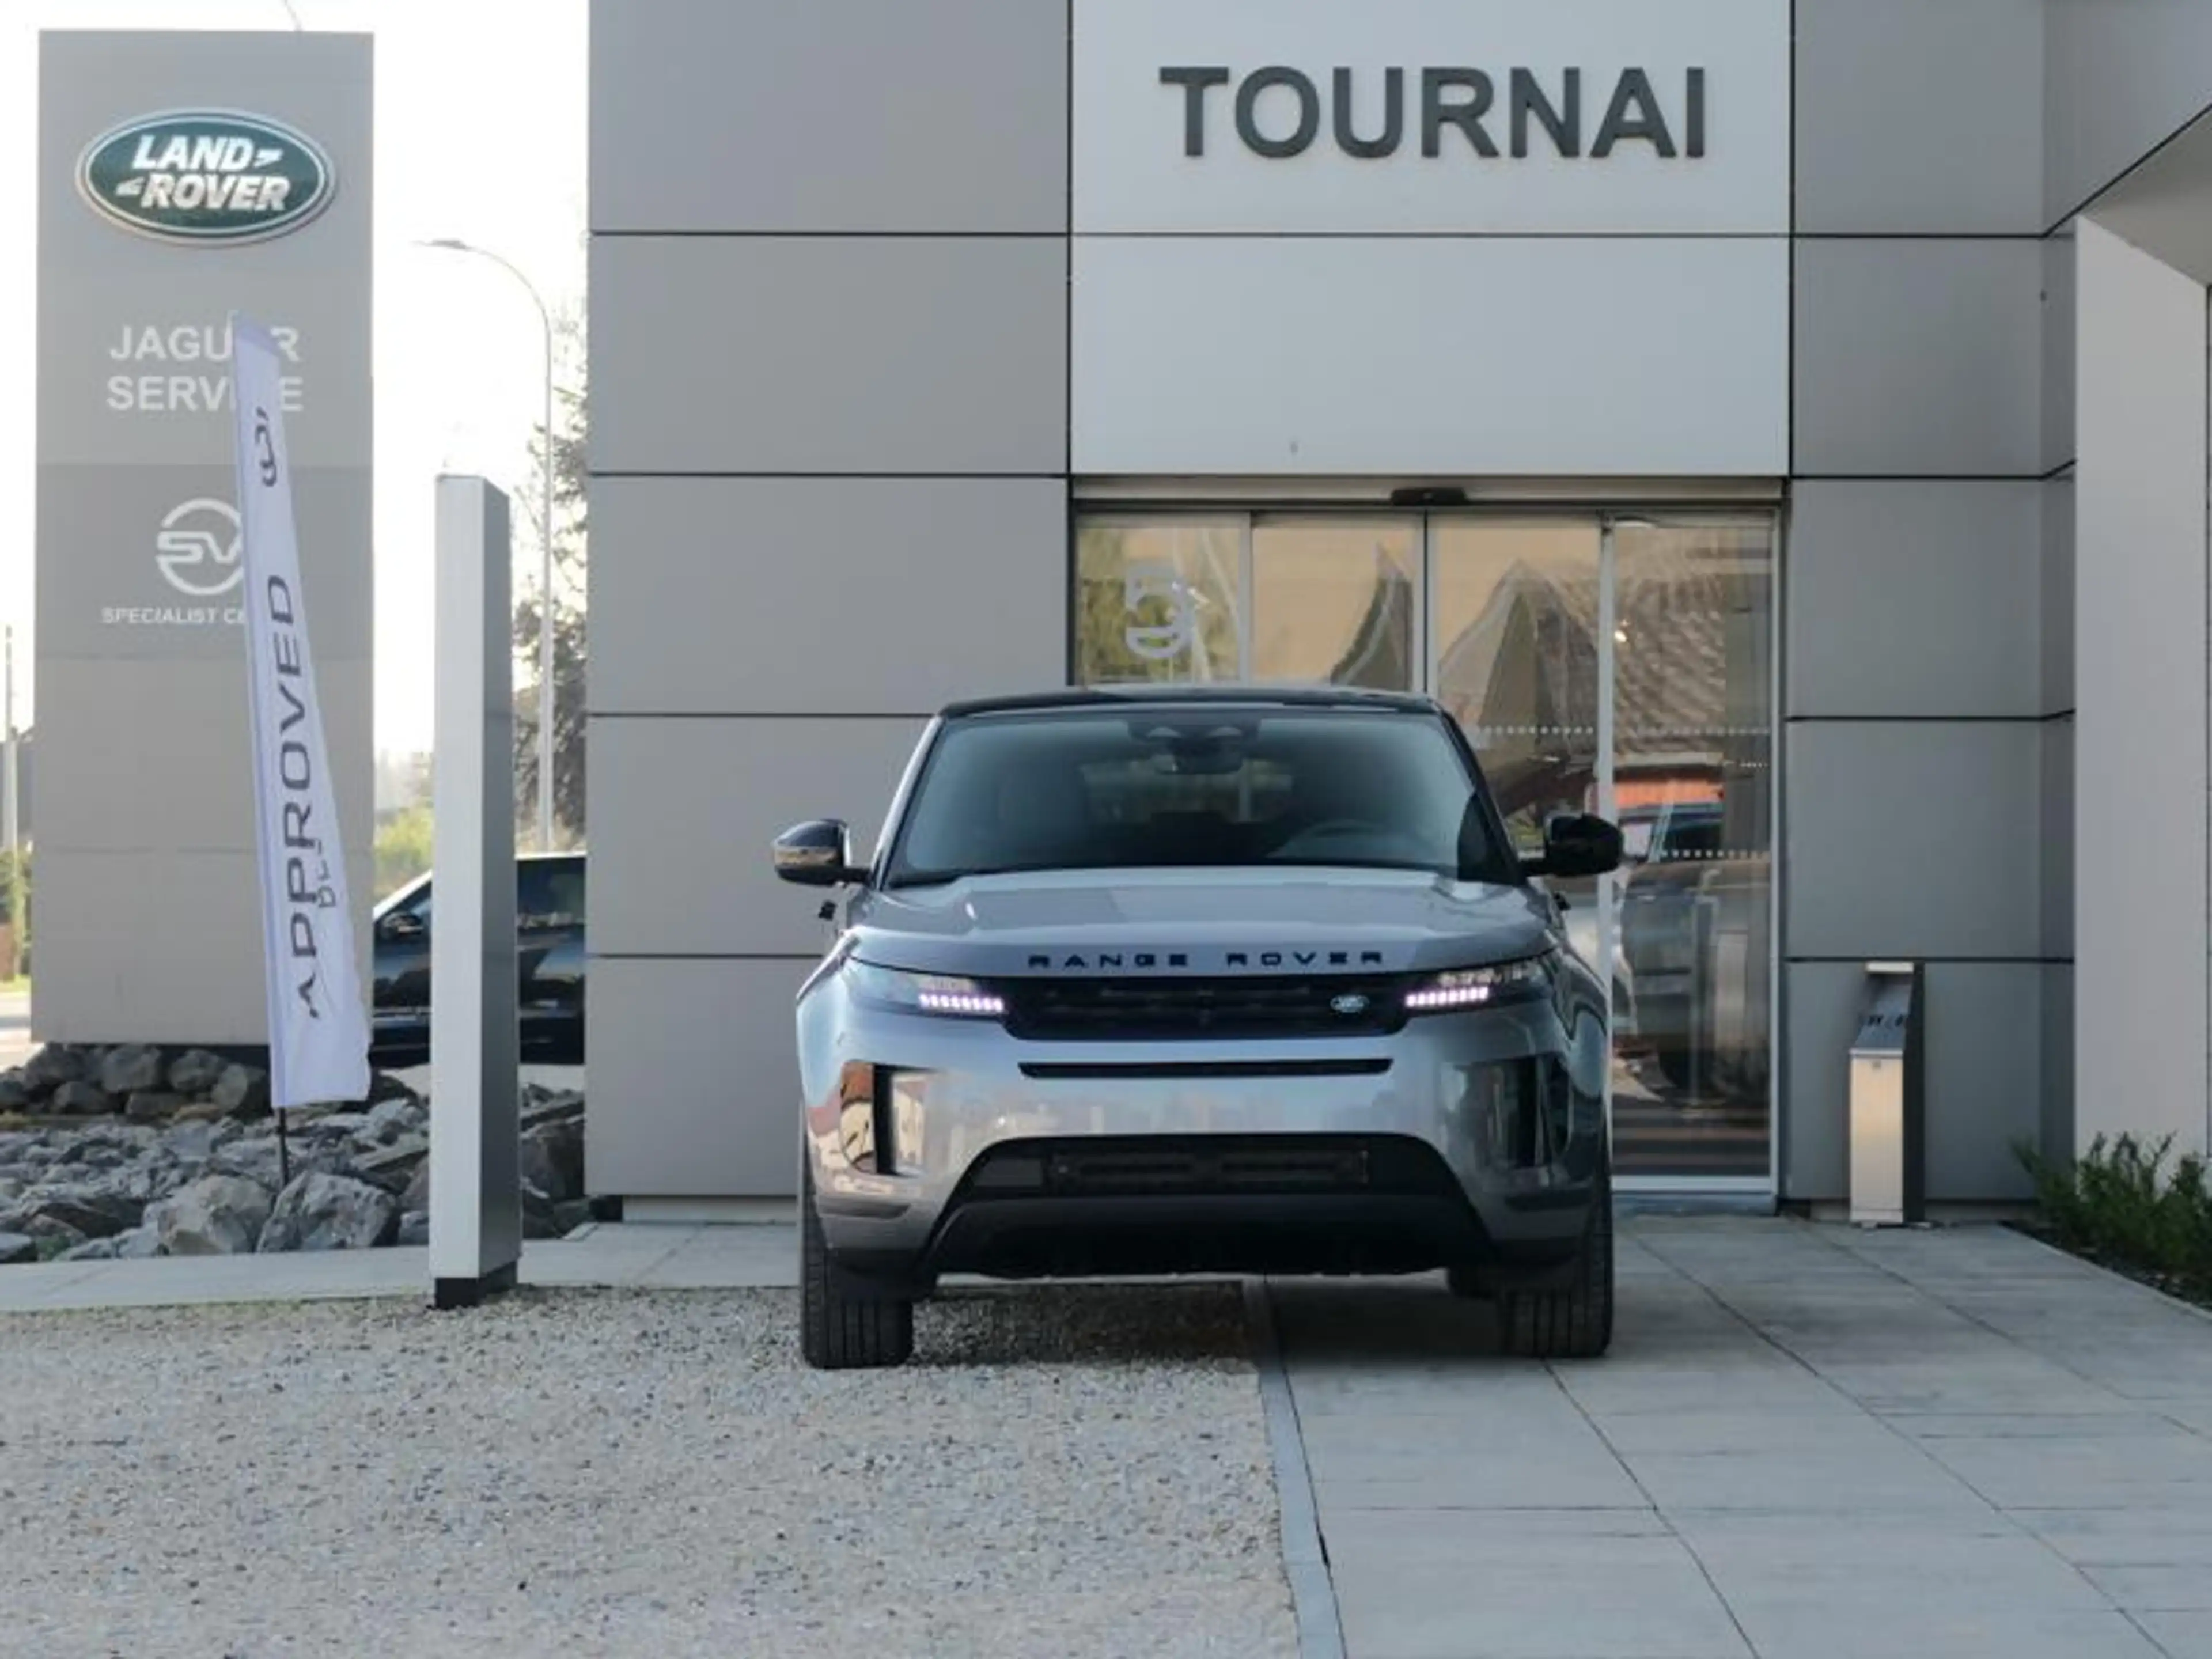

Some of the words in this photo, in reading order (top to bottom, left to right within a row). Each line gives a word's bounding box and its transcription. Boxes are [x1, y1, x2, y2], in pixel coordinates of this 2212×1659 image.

[1159, 66, 1706, 159] TOURNAI
[132, 135, 254, 171] LAND
[141, 173, 290, 211] ROVER
[110, 325, 301, 362] JAGUR
[101, 607, 218, 624] SPECIALIST
[1028, 953, 1187, 968] RANGE
[1226, 951, 1381, 967] ROVER
